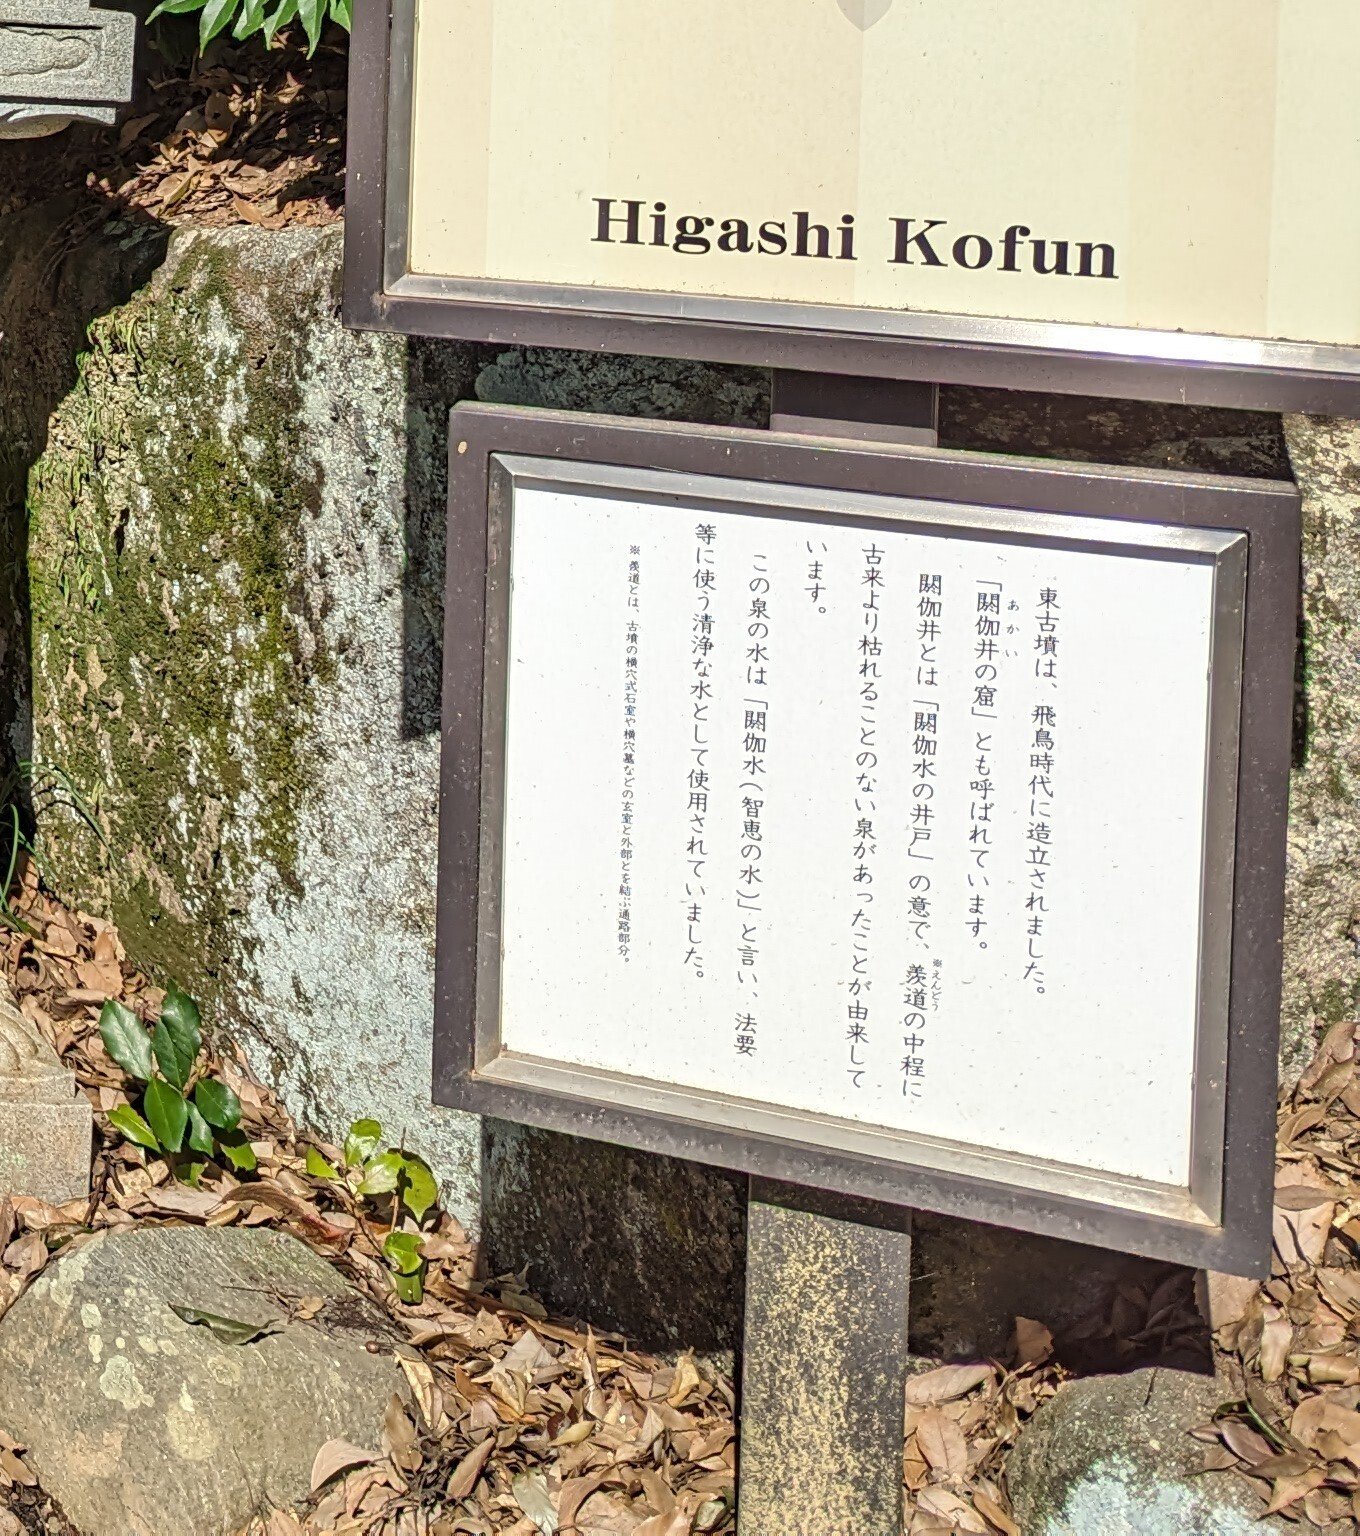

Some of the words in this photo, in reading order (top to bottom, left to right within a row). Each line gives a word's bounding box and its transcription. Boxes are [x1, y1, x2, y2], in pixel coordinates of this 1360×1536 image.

[591, 197, 857, 261] Higashi
[888, 217, 1119, 280] Kofun
[804, 540, 829, 615] います。
